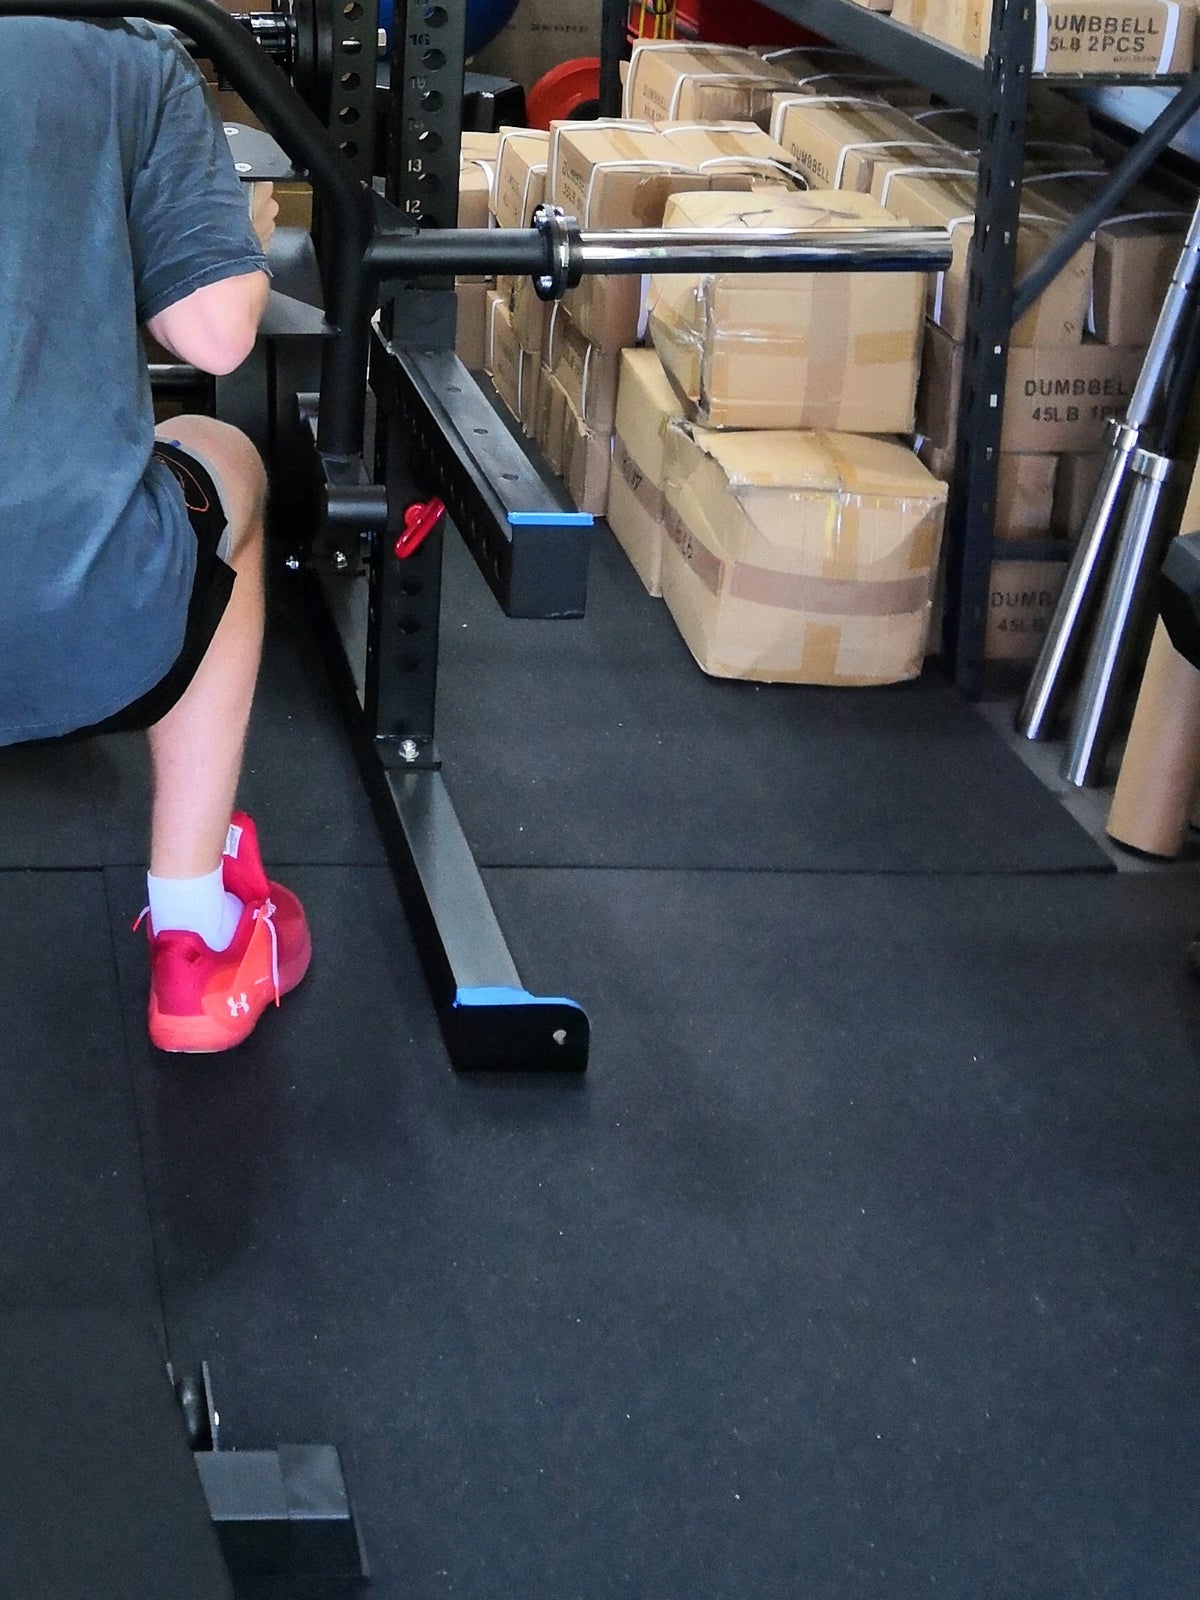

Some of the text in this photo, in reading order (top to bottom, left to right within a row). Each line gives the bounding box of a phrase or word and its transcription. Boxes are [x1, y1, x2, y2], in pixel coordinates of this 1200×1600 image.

[409, 33, 431, 46] 16
[1087, 36, 1146, 53] 2PCS
[407, 159, 423, 173] 13
[791, 142, 830, 184] DUMBBELL
[405, 199, 422, 214] 12
[1024, 379, 1127, 398] DUMBBEL
[990, 590, 1051, 609] DUMB
